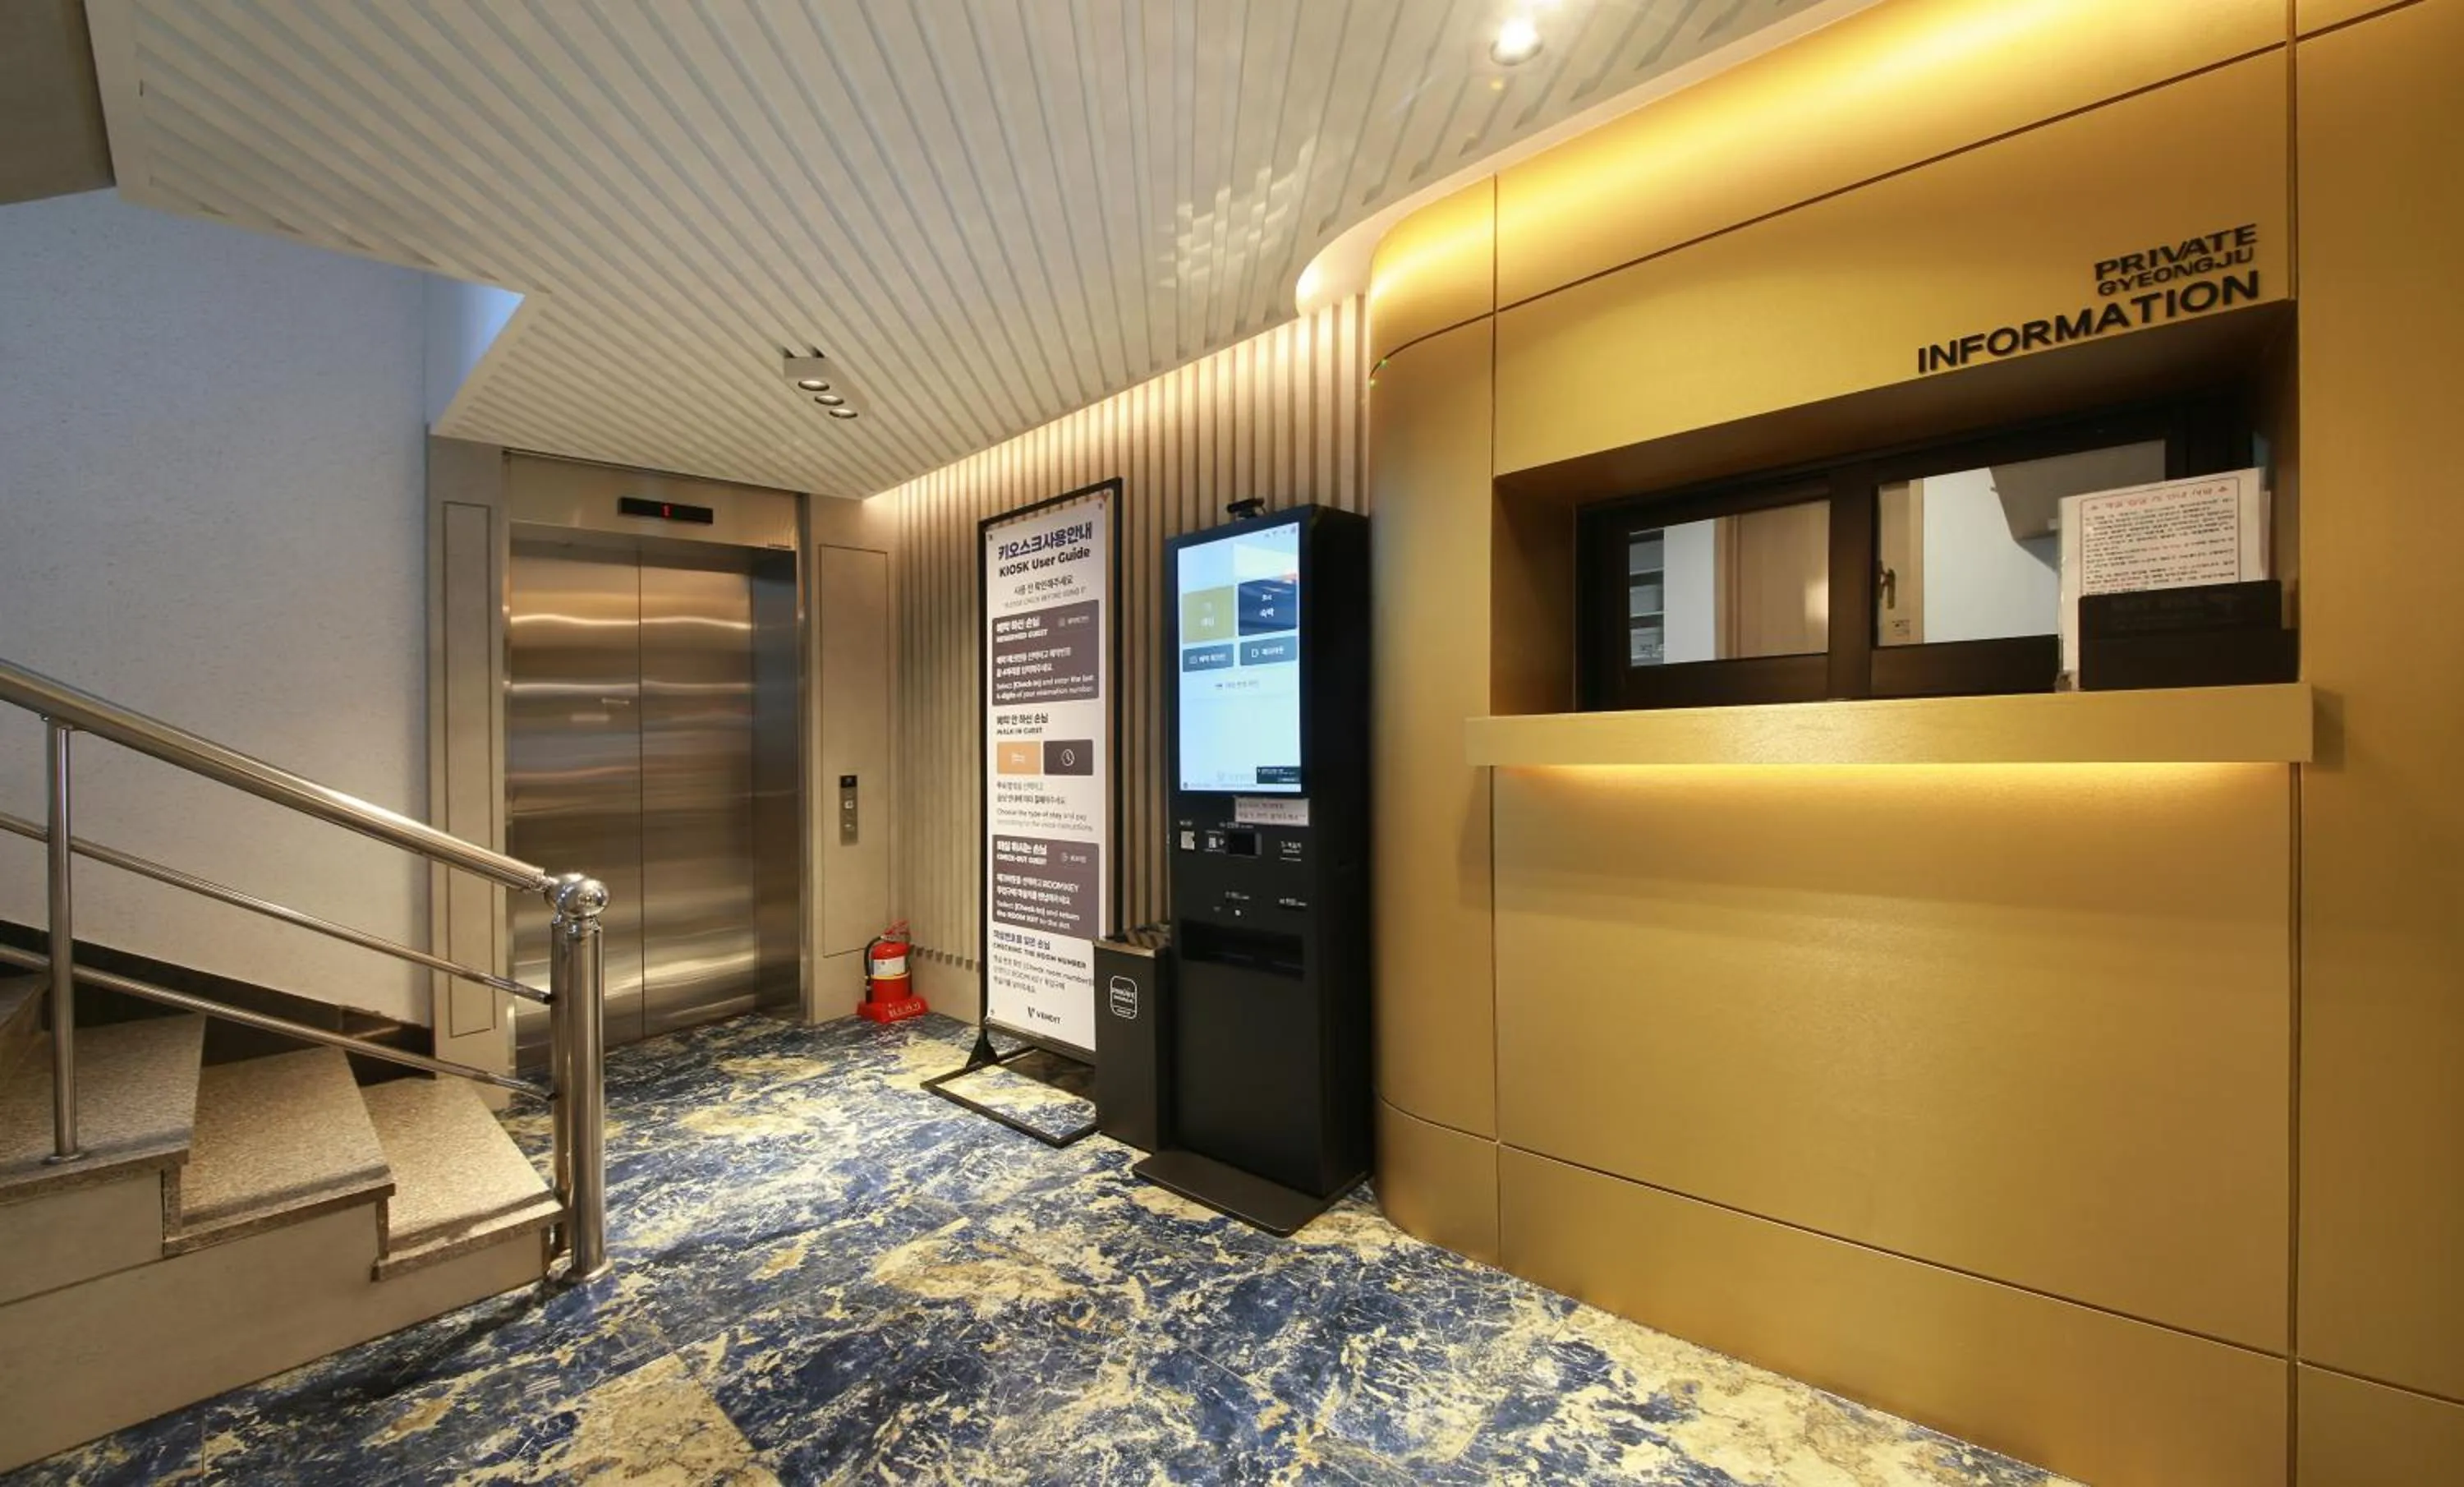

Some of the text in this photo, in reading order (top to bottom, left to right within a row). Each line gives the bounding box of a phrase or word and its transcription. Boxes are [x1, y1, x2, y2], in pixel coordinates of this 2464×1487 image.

[2094, 223, 2258, 282] PRIVATE
[2097, 246, 2255, 297] GYEONGJU
[1918, 269, 2259, 374] INFORMATION
[998, 522, 1093, 560] 키오스크사용안내
[999, 547, 1091, 578] KIOSK User Guide
[1026, 615, 1041, 628] 손님
[1034, 712, 1049, 724] 손님
[1023, 726, 1042, 734] GUEST
[997, 808, 1018, 816] Choose
[1027, 808, 1041, 818] type
[1050, 810, 1062, 820] stay
[1007, 911, 1026, 921] ROOM
[1036, 951, 1056, 961] ROOM
[1057, 956, 1087, 969] NUMBER
[1036, 1011, 1062, 1024] VENDIT
